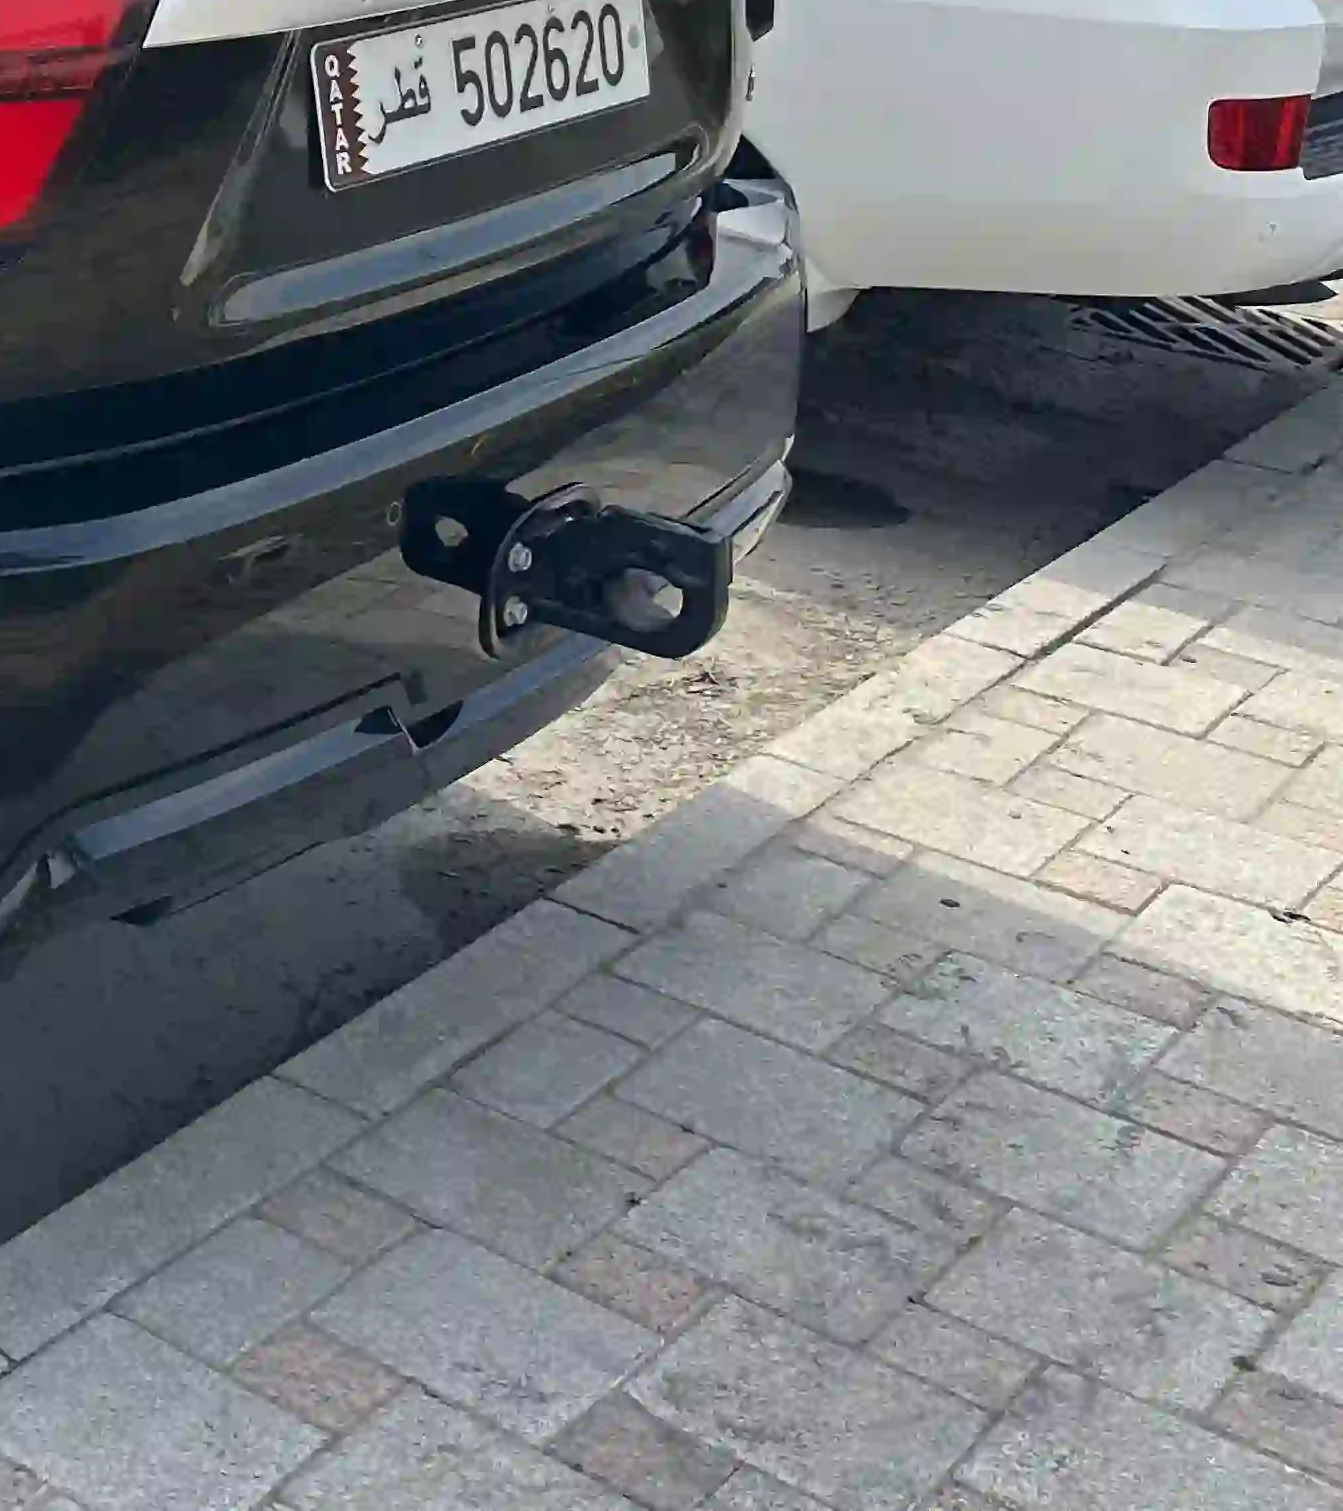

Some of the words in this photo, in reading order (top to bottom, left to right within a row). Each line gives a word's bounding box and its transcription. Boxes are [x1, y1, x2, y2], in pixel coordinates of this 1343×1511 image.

[324, 54, 353, 176] QATAR
[368, 56, 432, 145] قطر
[450, 2, 625, 127] 502620
